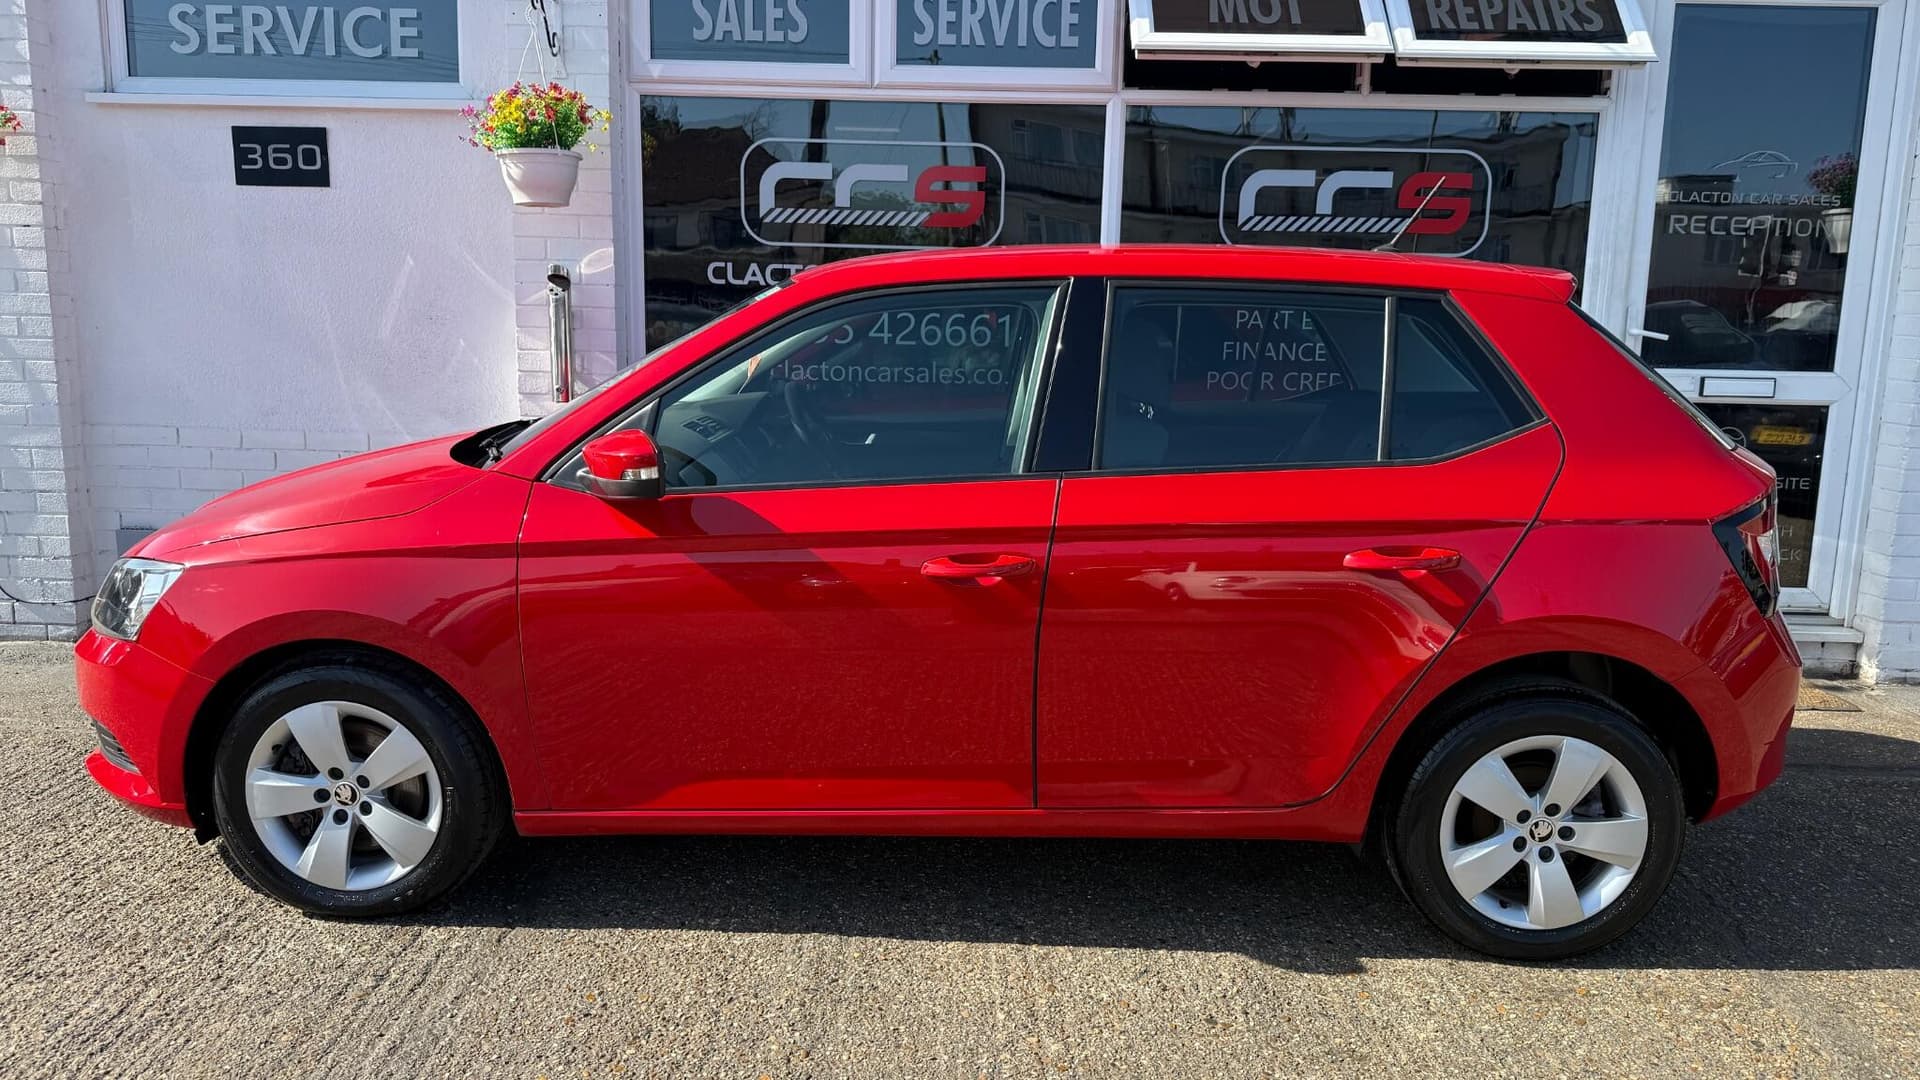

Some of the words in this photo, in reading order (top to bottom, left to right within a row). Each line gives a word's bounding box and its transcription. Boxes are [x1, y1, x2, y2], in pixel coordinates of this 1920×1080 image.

[168, 2, 420, 58] SERVICE
[692, 0, 808, 42] SALES
[912, 0, 1080, 48] SERVICE
[1426, 0, 1604, 31] REPAIRS
[239, 143, 322, 170] 360
[1669, 190, 1745, 203] CLACTON
[1750, 192, 1783, 205] CAR
[1788, 194, 1842, 207] SALES
[1668, 214, 1834, 238] RECEPTION
[707, 261, 820, 286] CLACT
[868, 312, 1012, 348] 426661
[1223, 341, 1326, 362] FINANCE
